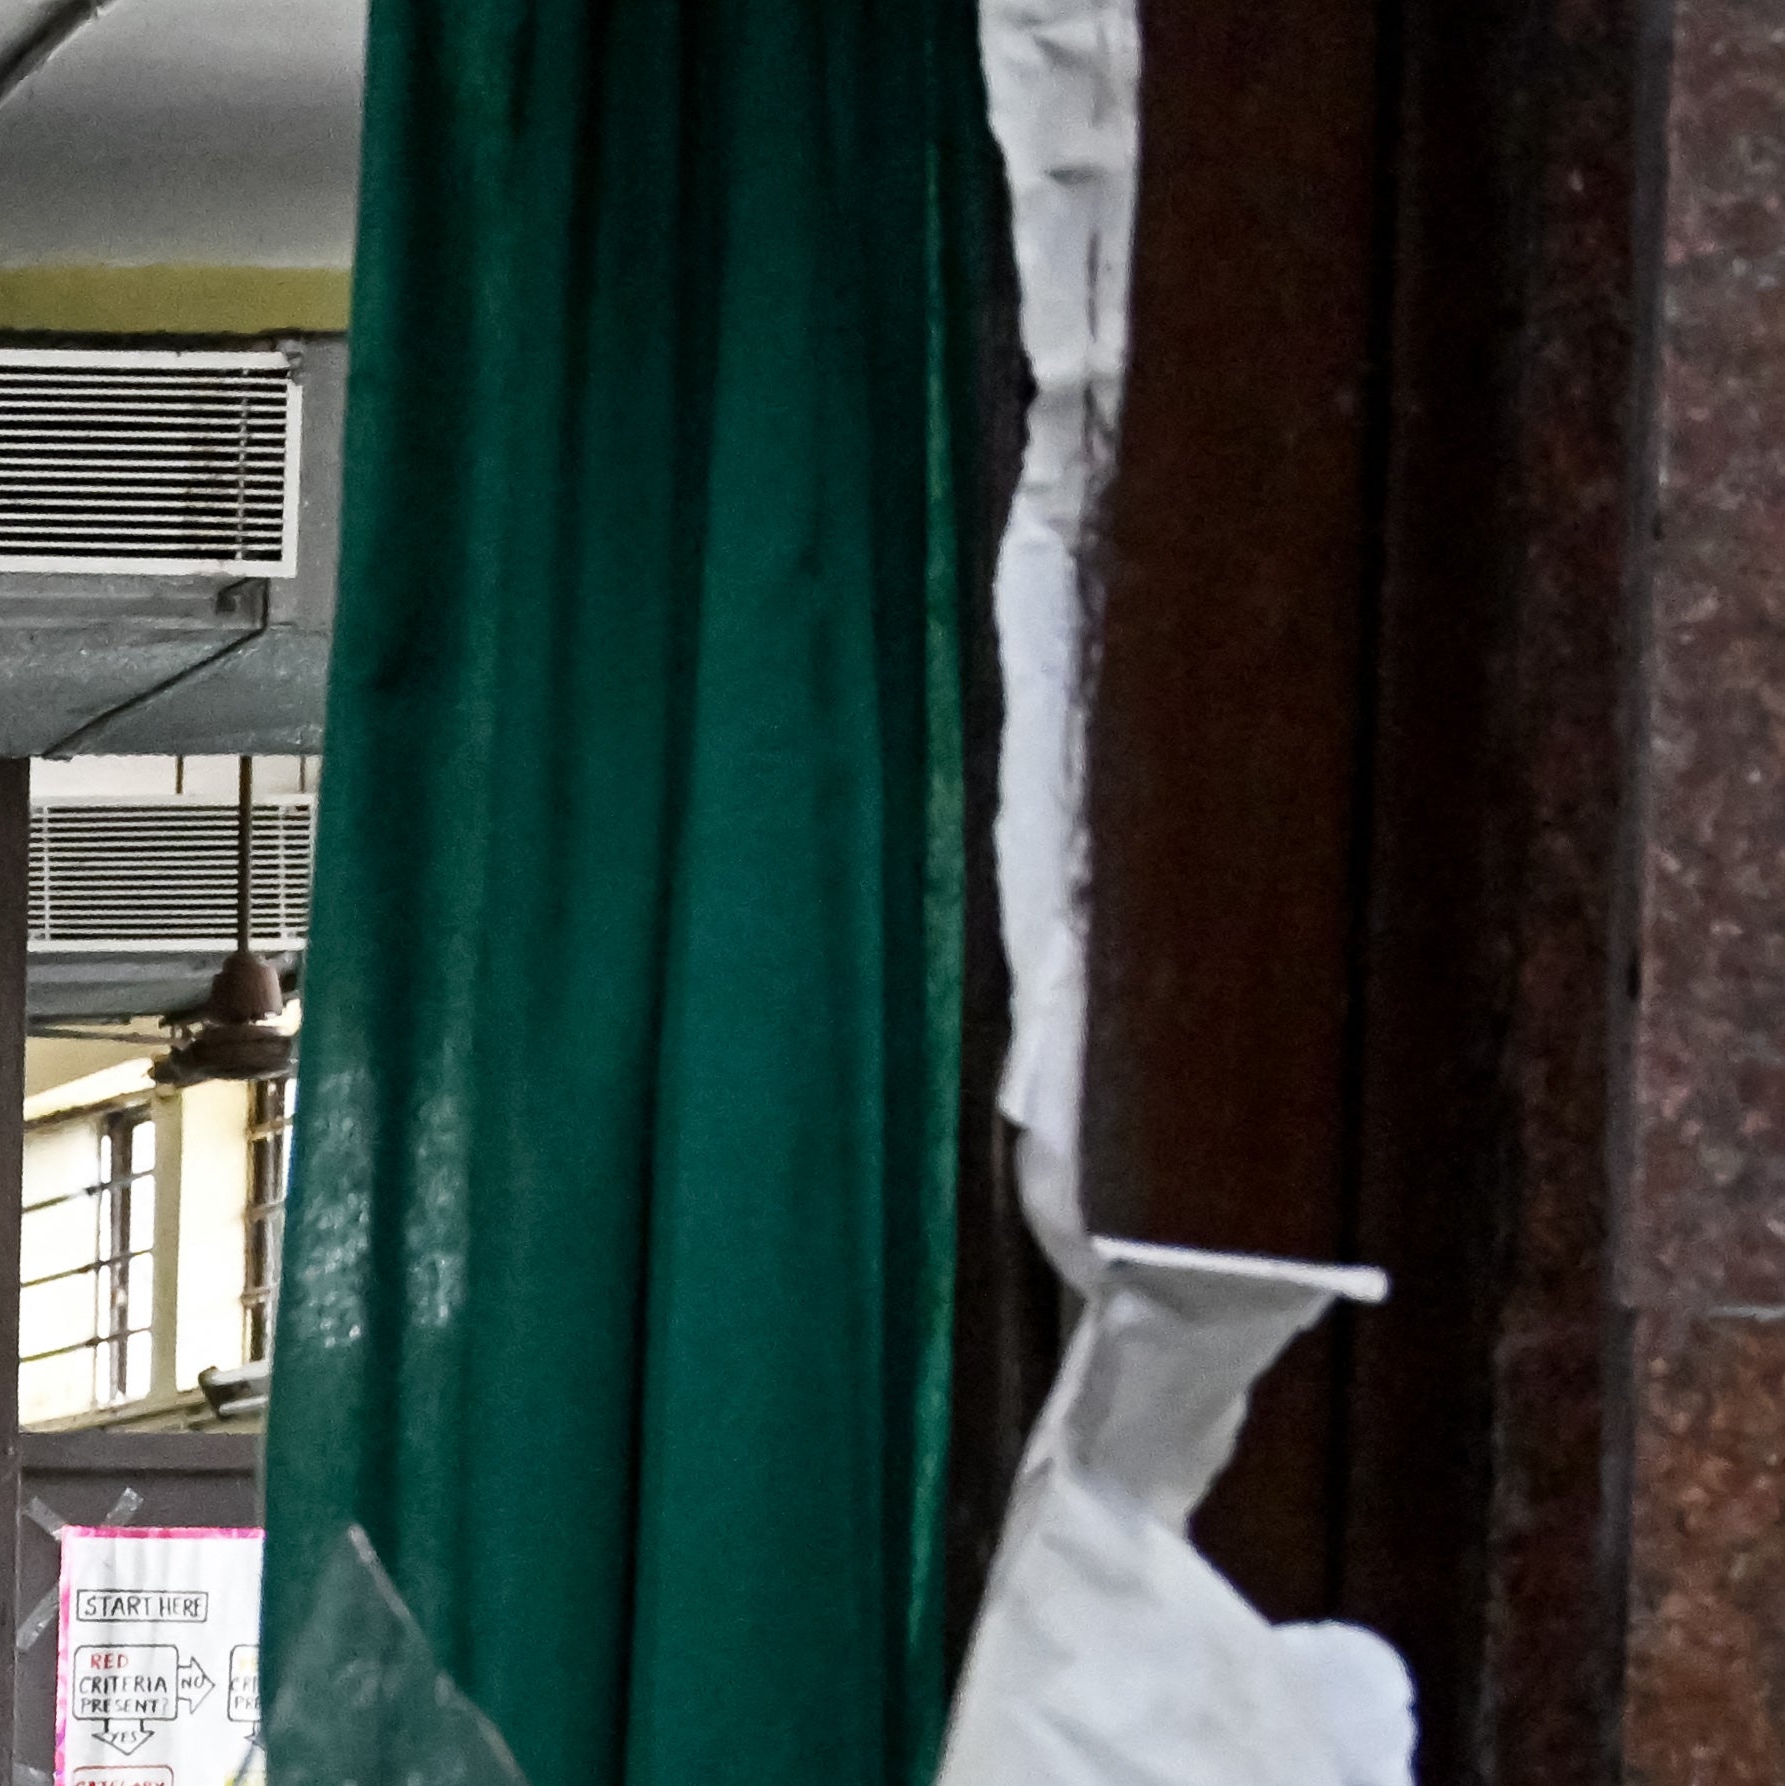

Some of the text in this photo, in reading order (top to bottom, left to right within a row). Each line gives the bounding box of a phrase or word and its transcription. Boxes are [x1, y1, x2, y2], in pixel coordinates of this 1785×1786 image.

[84, 1595, 202, 1617] START HERE
[91, 1653, 129, 1669] RED
[79, 1676, 168, 1694] CRITERIA
[181, 1675, 206, 1689] NO
[81, 1698, 169, 1713] PRESENT?
[110, 1731, 137, 1744] YES
